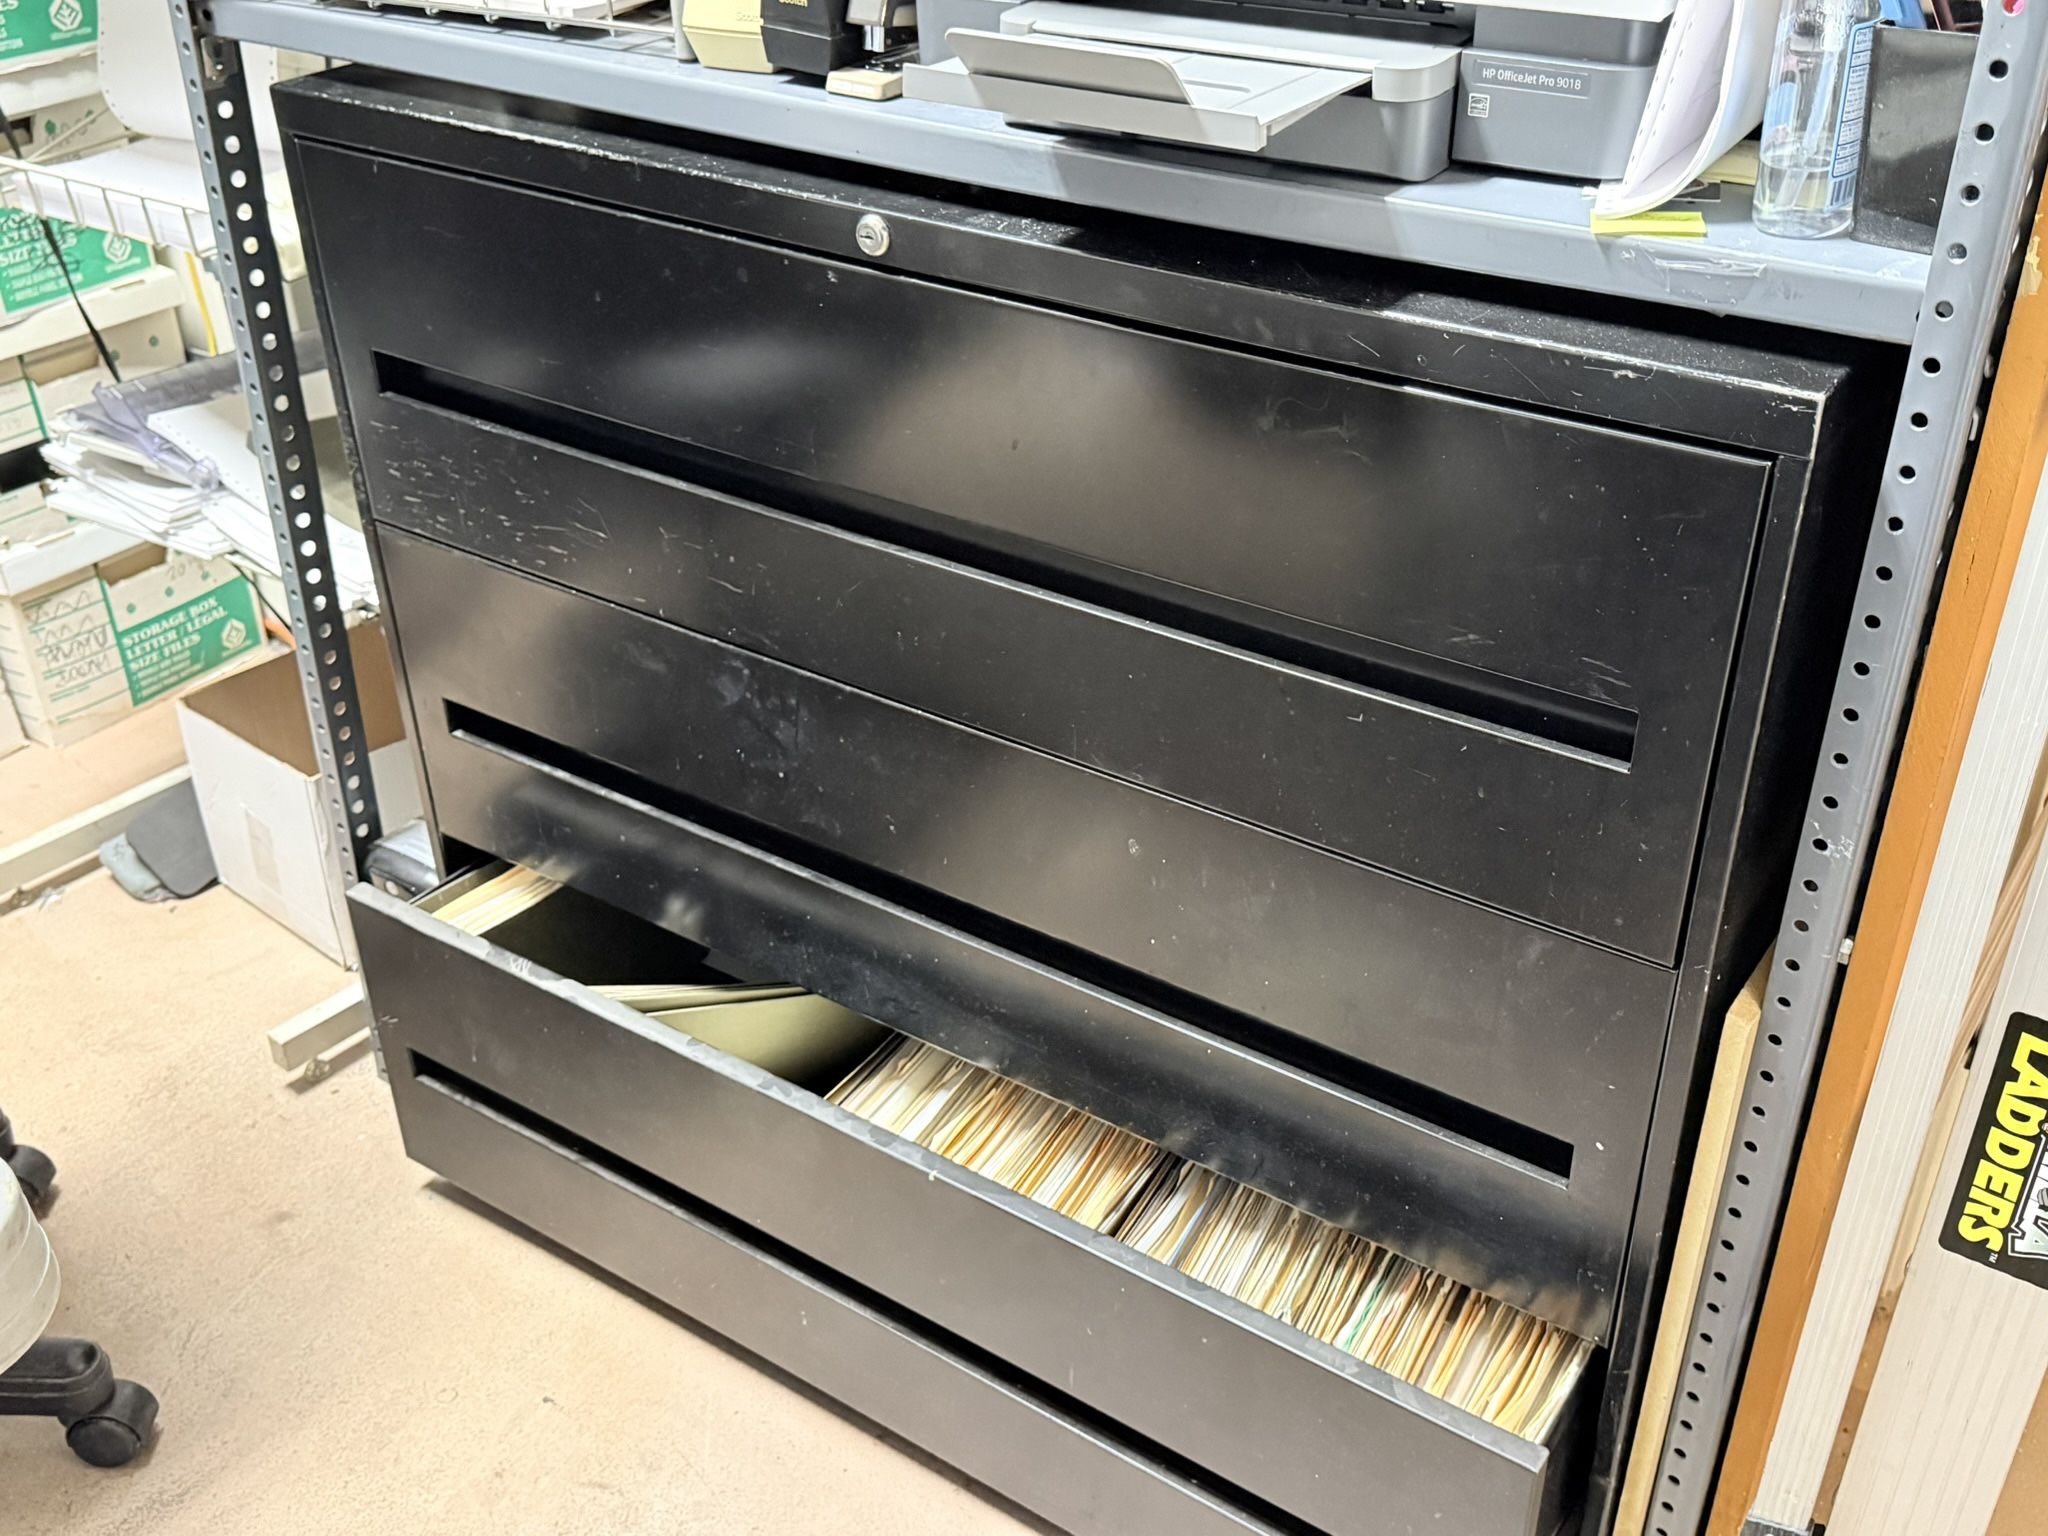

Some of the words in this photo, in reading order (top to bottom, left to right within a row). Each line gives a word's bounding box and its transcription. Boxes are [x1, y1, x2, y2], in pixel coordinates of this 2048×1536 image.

[1482, 68, 1496, 80] HP
[1497, 69, 1537, 85] OfficeJet
[1538, 75, 1555, 87] Pro
[1556, 77, 1582, 90] 9018
[122, 610, 189, 648] STORAGE
[189, 597, 218, 618] BOX
[126, 629, 178, 660] LETTER
[186, 606, 228, 632] LEGAL
[130, 650, 161, 673] SIZE
[162, 633, 201, 658] FILES
[1957, 1032, 2048, 1252] LADDERS
